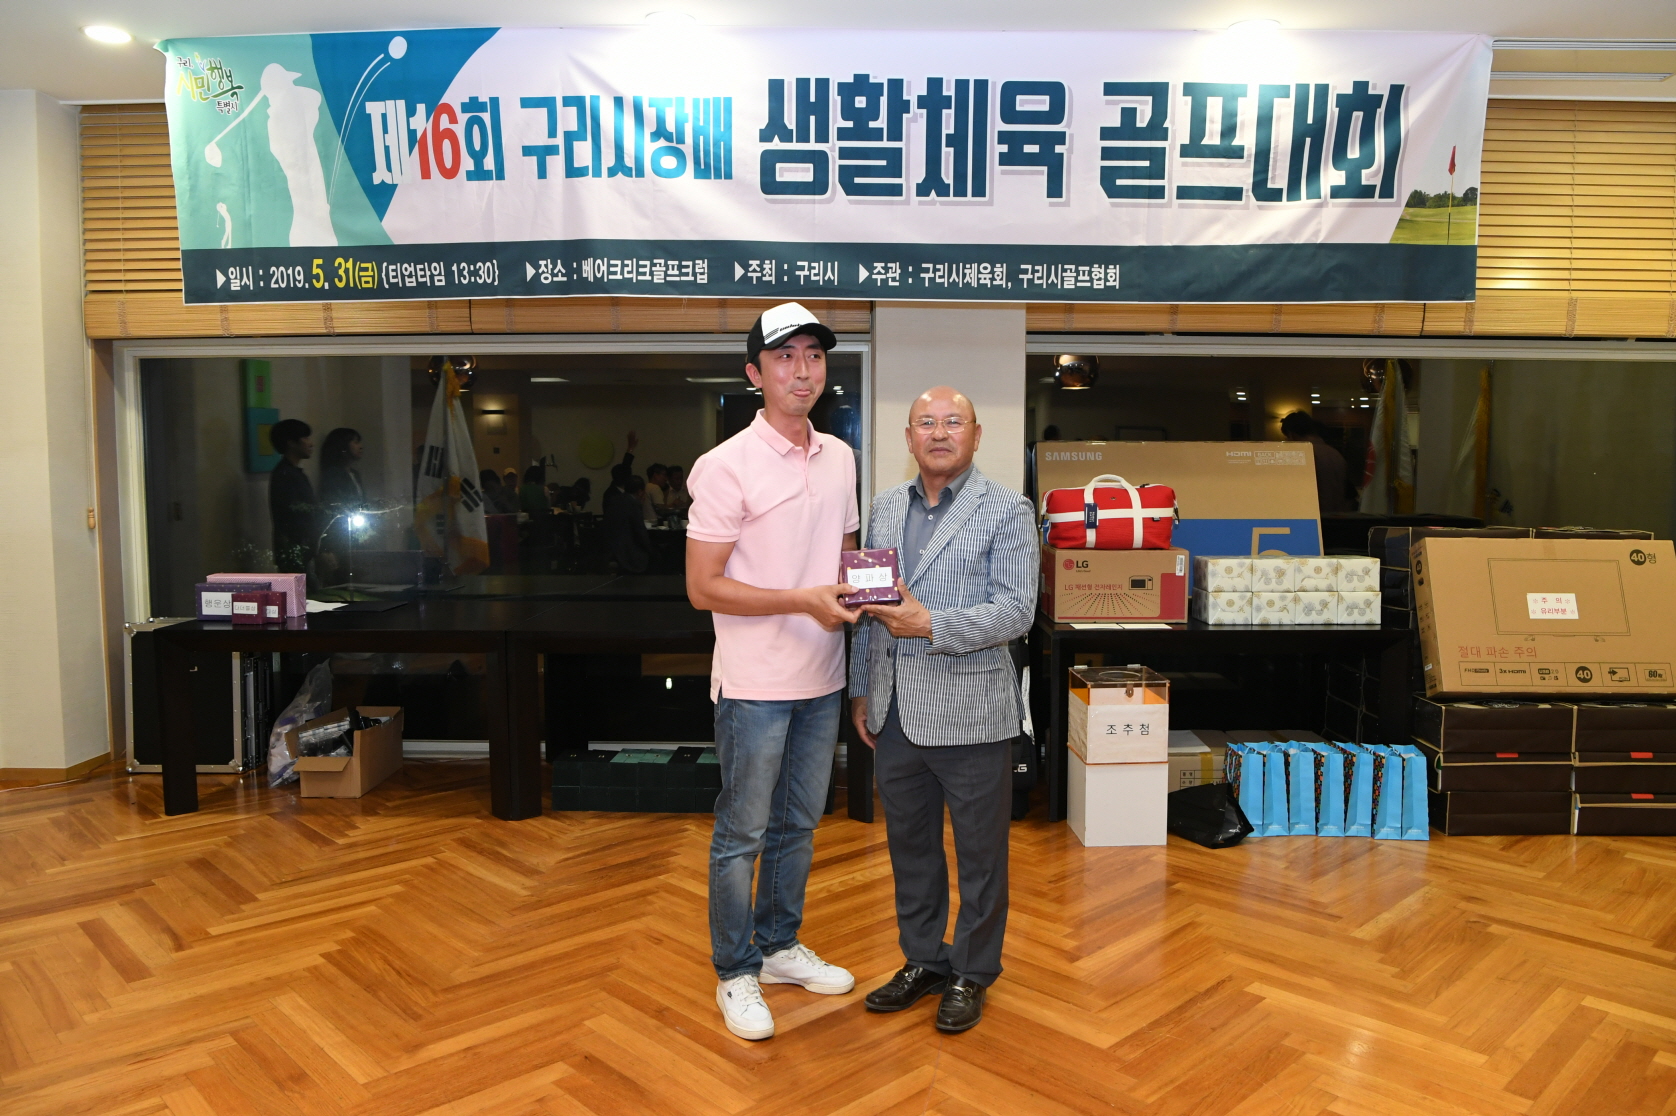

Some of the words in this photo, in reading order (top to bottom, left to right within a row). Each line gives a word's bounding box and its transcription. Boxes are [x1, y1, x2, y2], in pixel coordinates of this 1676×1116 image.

[216, 100, 238, 114] 특별시
[366, 96, 505, 185] 제16회
[520, 95, 733, 180] 구리시장배
[759, 74, 1067, 199] 생활체육
[1099, 80, 1405, 202] 골프대회
[228, 266, 253, 290] 일시
[381, 261, 446, 289] {티업타임
[451, 259, 499, 287] 13:30}
[538, 259, 567, 284] 장소
[582, 257, 708, 284] 베어크리크골프크럽
[748, 259, 776, 285] 주최
[795, 260, 839, 286] 구리시
[872, 262, 901, 286] 주관
[920, 262, 1012, 290] 구리시체육회,
[1018, 263, 1120, 290] 구리시골프협회
[1045, 452, 1103, 461] SAMSUNG
[1076, 560, 1089, 569] LG
[1458, 646, 1481, 659] 절대
[1486, 646, 1509, 659] 파손
[1514, 646, 1537, 659] 주의
[1576, 669, 1592, 679] 40
[1105, 723, 1149, 736] 조추첨
